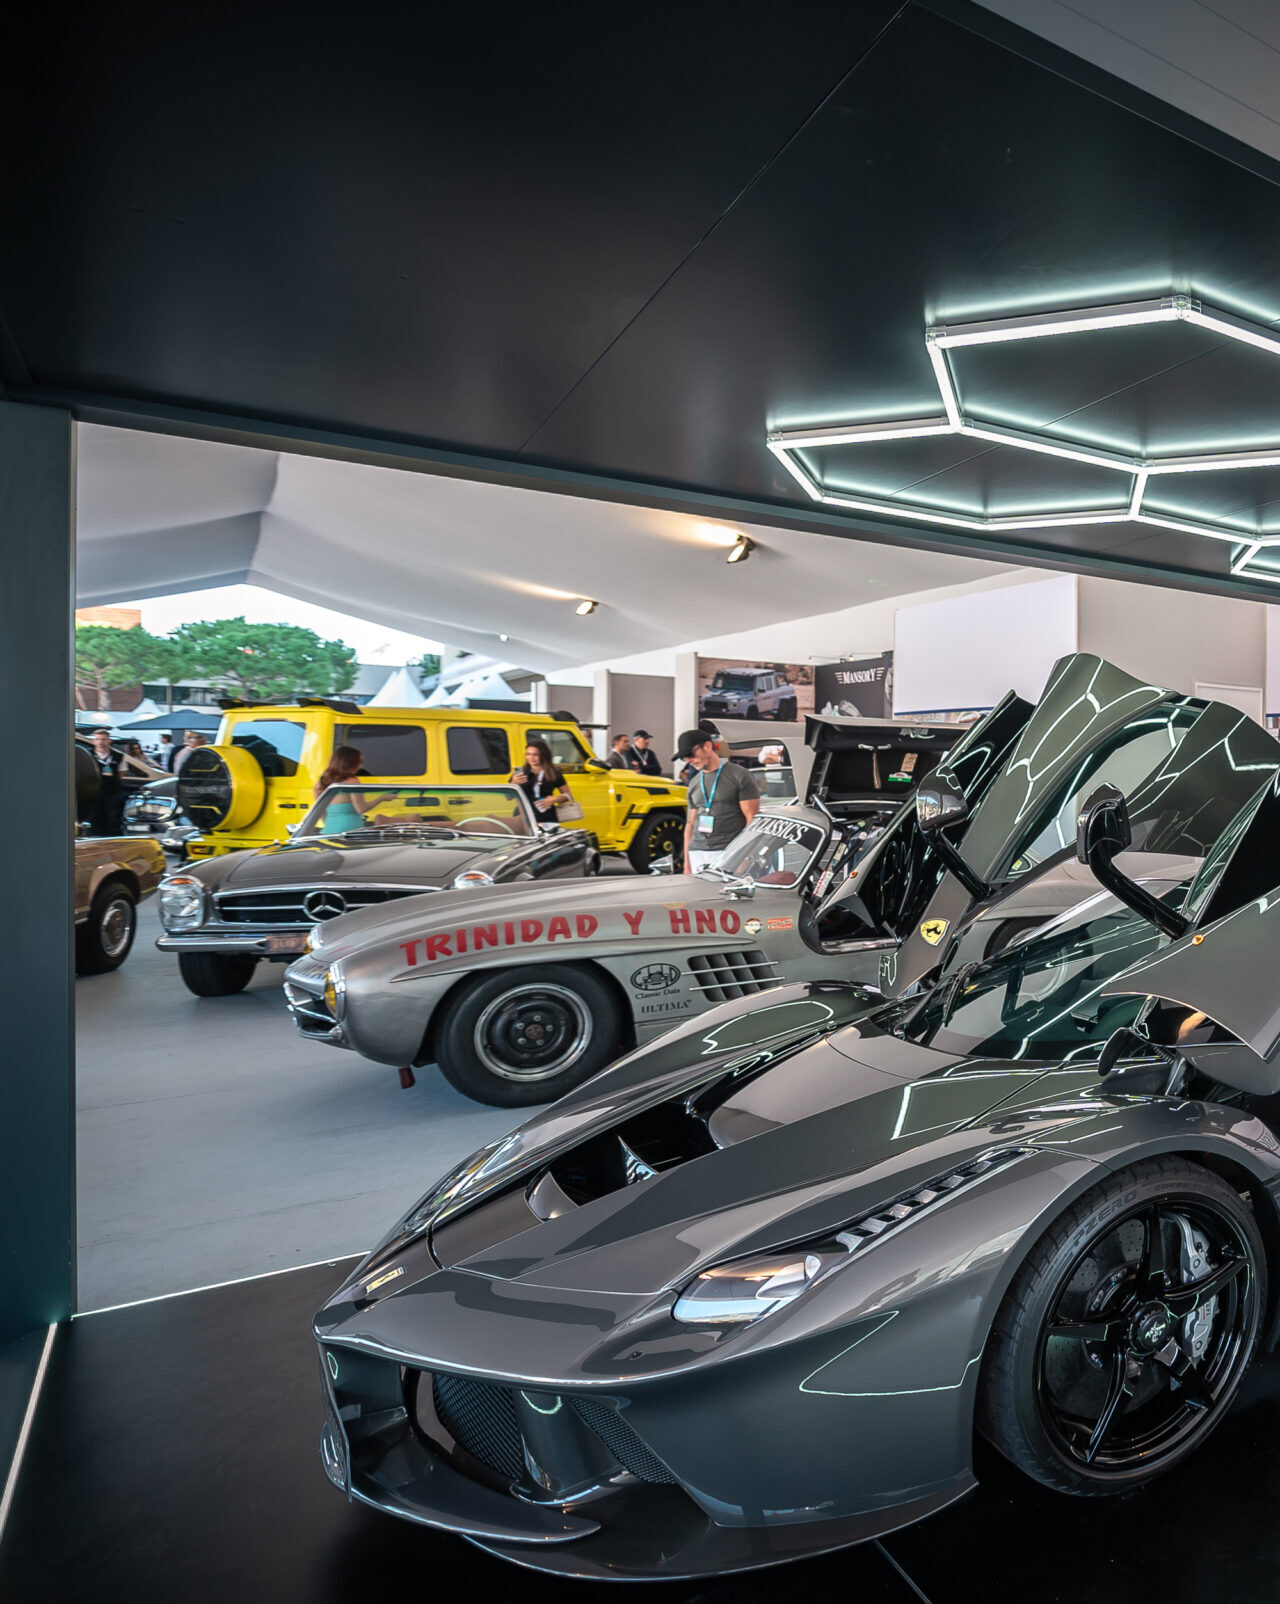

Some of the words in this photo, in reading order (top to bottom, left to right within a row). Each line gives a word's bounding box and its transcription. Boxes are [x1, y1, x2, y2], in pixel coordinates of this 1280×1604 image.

[842, 668, 876, 684] MANSORY
[752, 818, 810, 842] CLASSICS
[398, 914, 599, 966] TRINIDAD
[622, 909, 645, 936] Y
[668, 908, 742, 936] HNO
[635, 991, 661, 1000] Classic
[663, 988, 681, 996] Data
